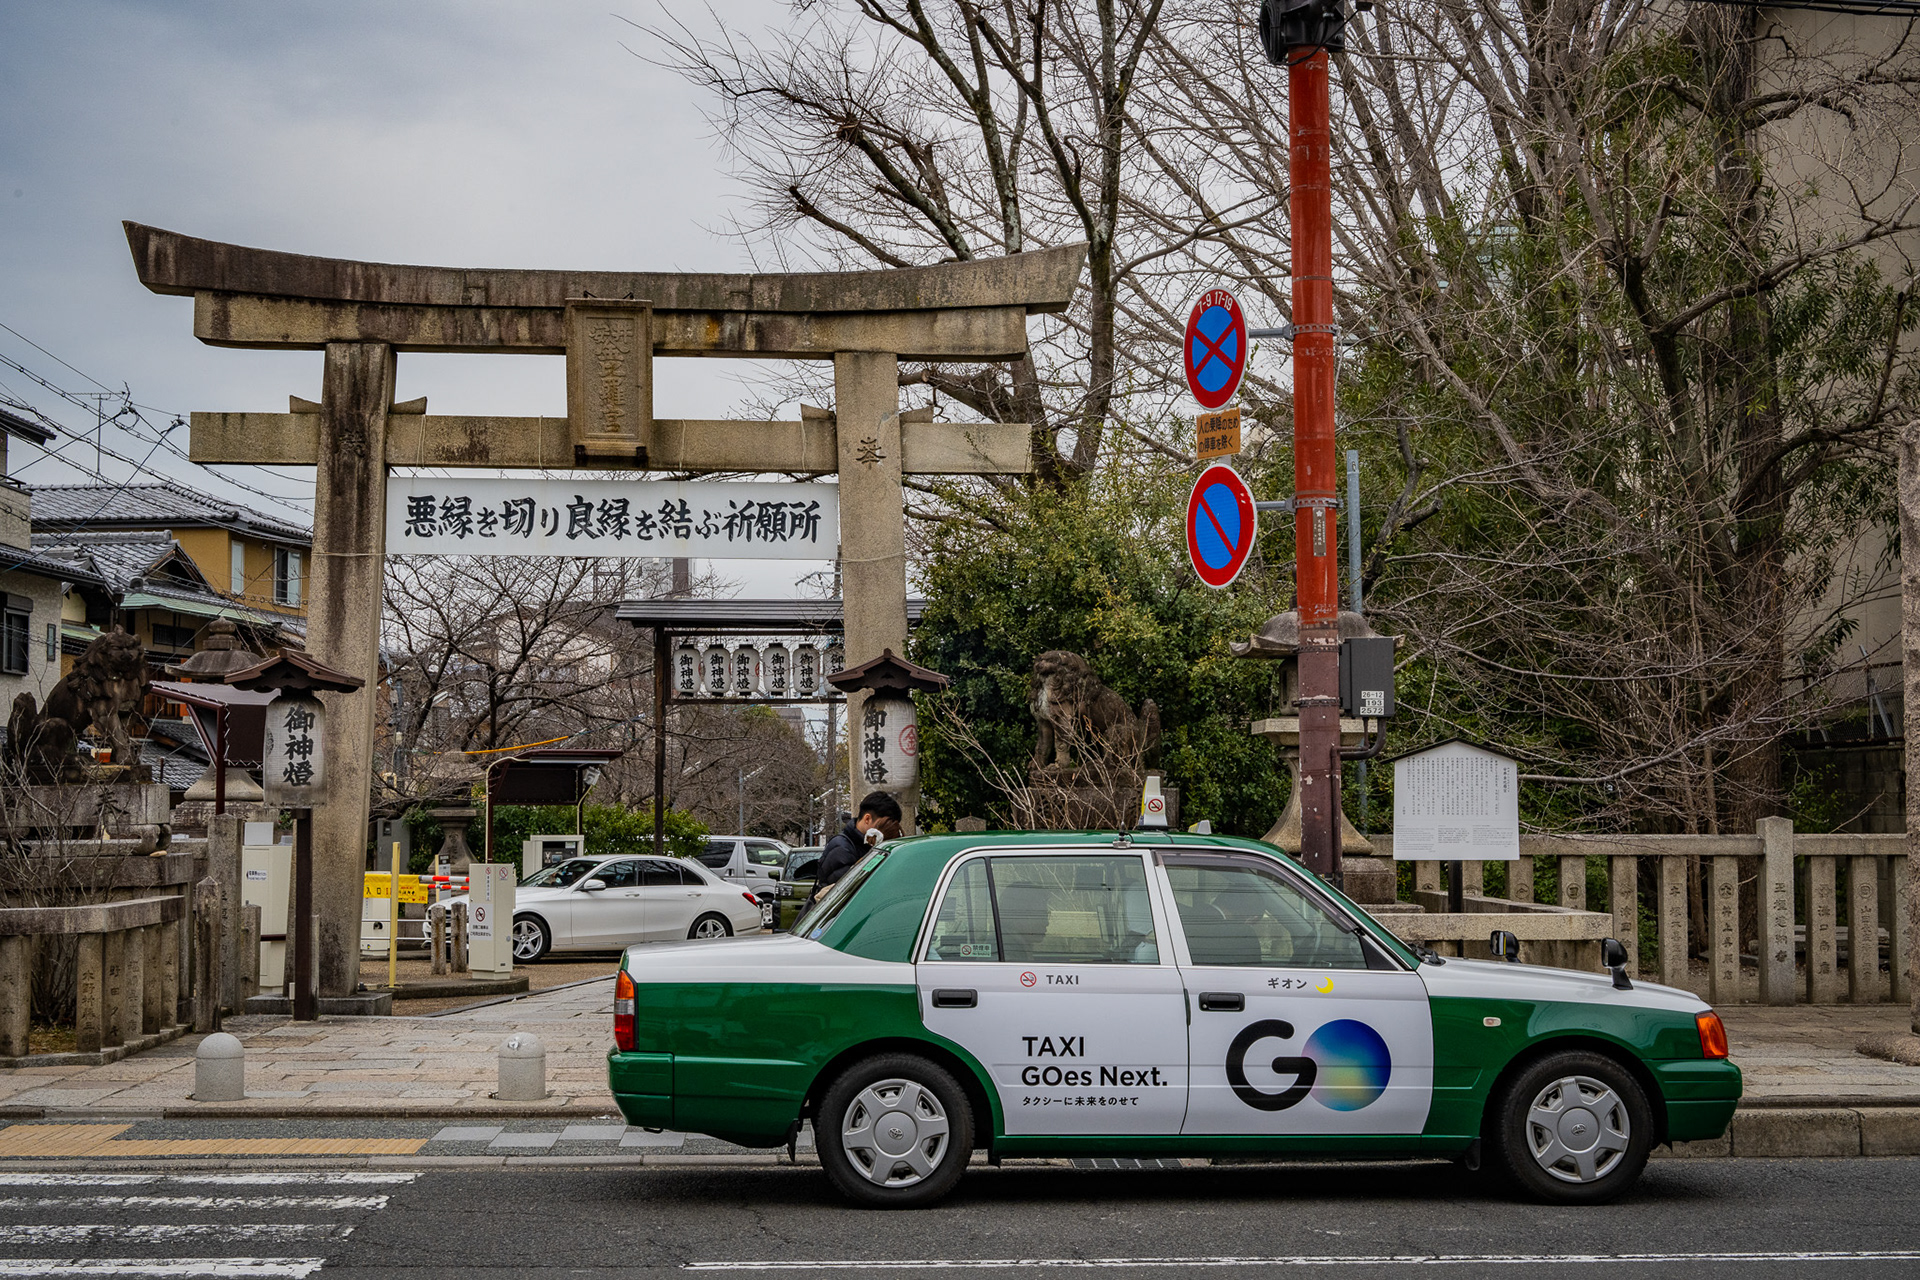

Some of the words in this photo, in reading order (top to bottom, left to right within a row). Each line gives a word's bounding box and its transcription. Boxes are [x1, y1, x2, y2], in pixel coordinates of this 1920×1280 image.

[1197, 293, 1212, 313] 7-9
[1214, 291, 1233, 311] 17-19
[1198, 416, 1239, 434] 人の乗降のため
[1199, 435, 1234, 453] の停車を除く
[404, 493, 823, 545] 悪縁を切り良縁を結ぶ祈願所
[679, 653, 694, 690] 御神燈
[710, 653, 725, 690] 御神燈
[736, 653, 750, 690] 御神燈
[771, 653, 786, 690] 御神燈
[800, 653, 814, 690] 御神燈
[282, 704, 316, 787] 御神燈
[863, 707, 888, 785] 御神燈
[1046, 974, 1079, 985] TAXI
[1267, 977, 1307, 990] ギオン
[1022, 1036, 1085, 1057] TAXI
[1022, 1065, 1093, 1087] GOes
[1099, 1065, 1168, 1087] Next.
[1022, 1096, 1139, 1106] タクシーに未来をのせて
